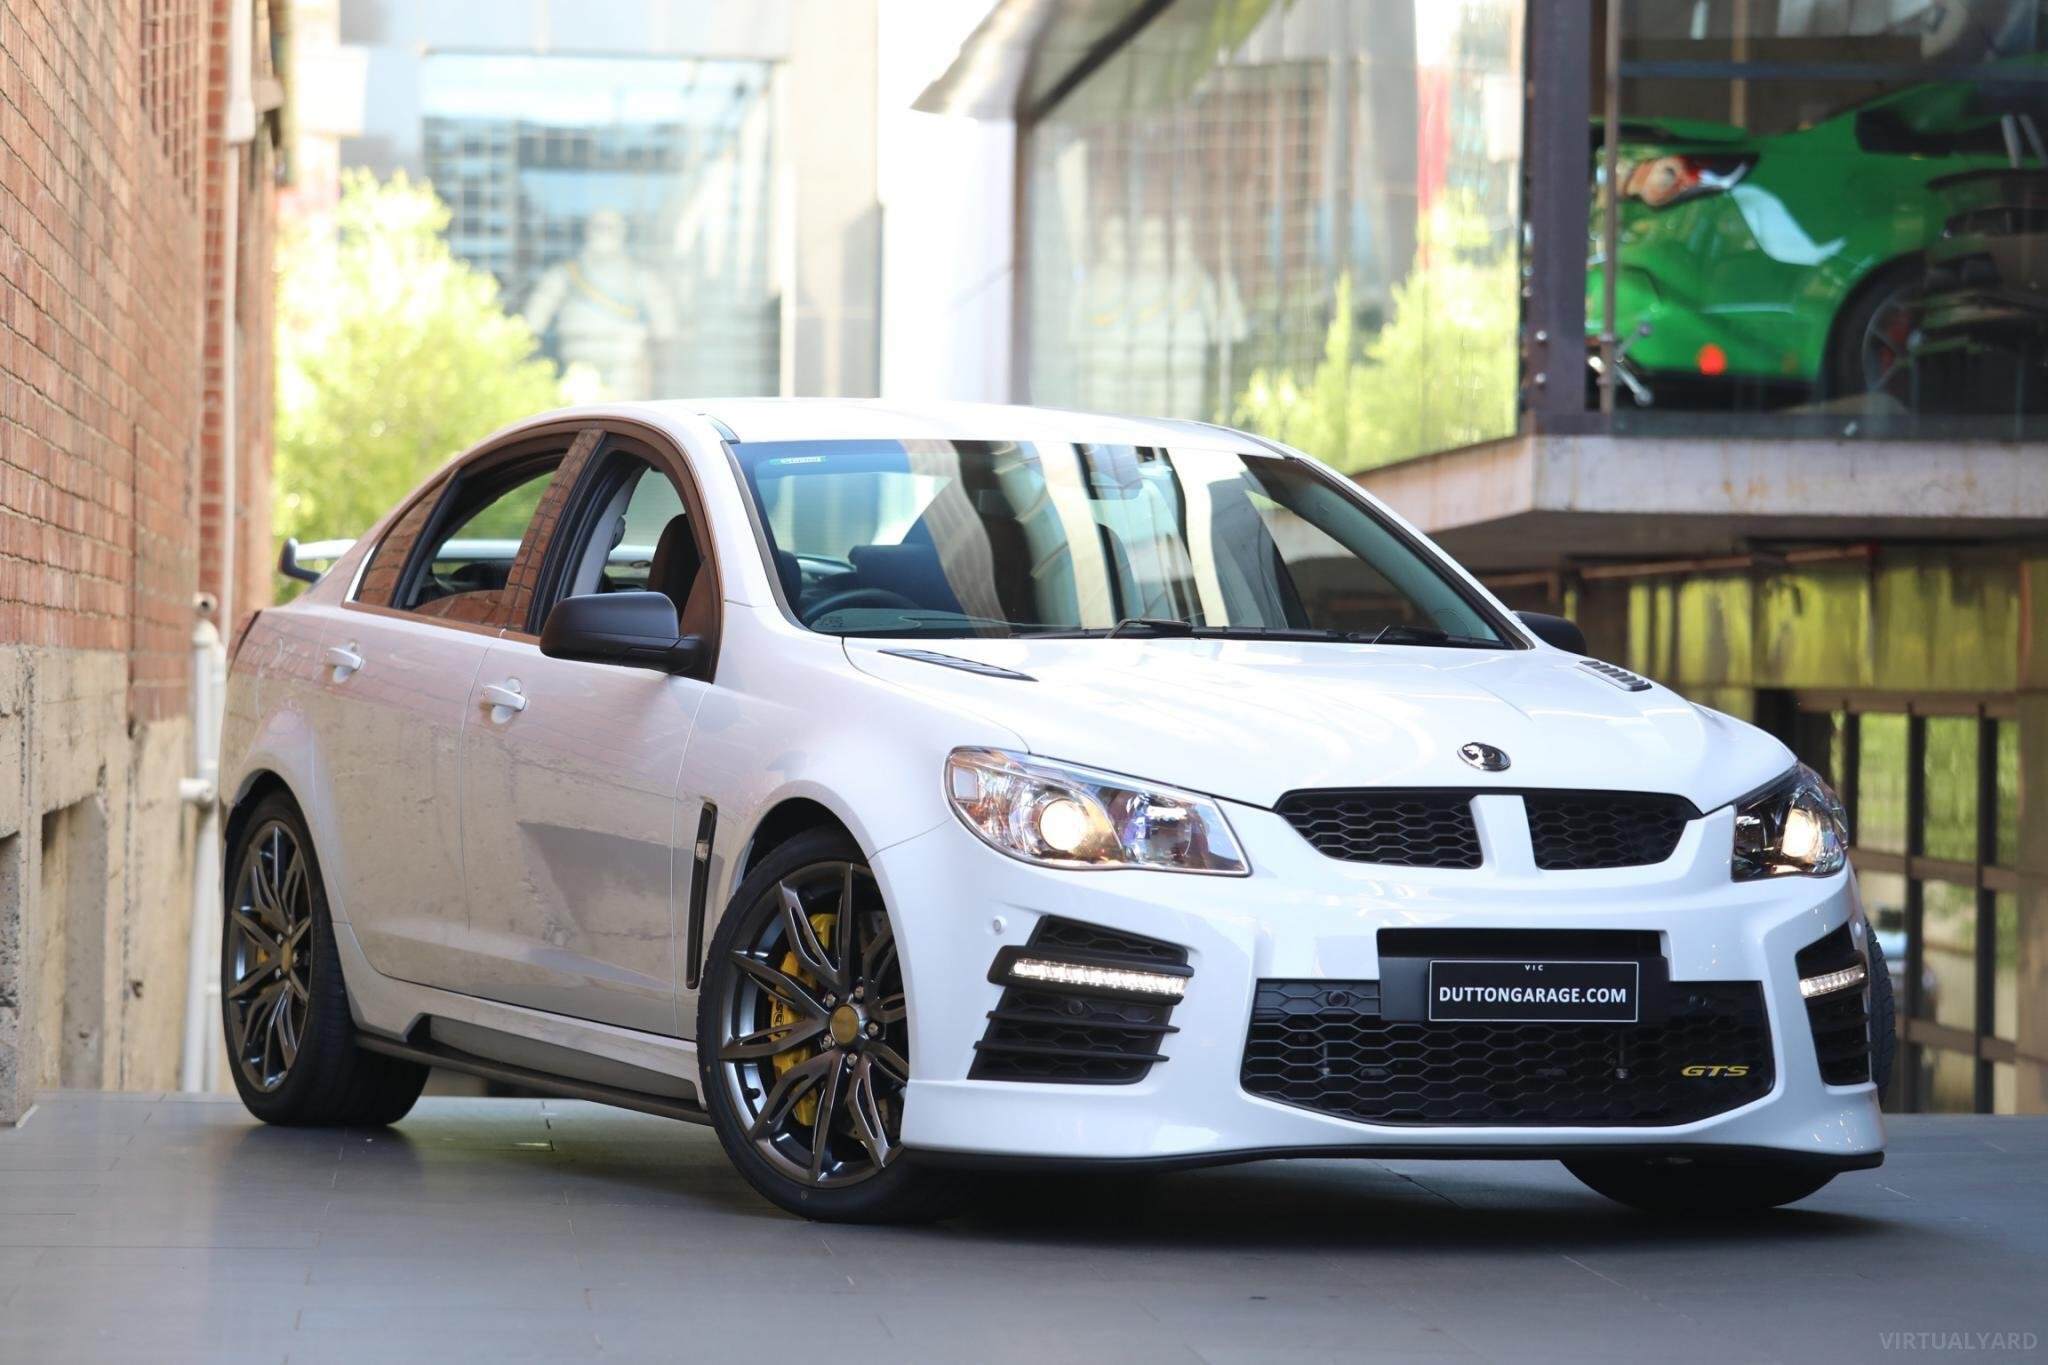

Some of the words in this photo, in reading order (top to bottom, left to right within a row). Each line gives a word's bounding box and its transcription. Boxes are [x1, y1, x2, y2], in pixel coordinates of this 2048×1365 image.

[1524, 964, 1544, 972] VIC
[1439, 986, 1626, 1004] DUTTONGARAGE.COM
[1681, 1065, 1750, 1077] GTS
